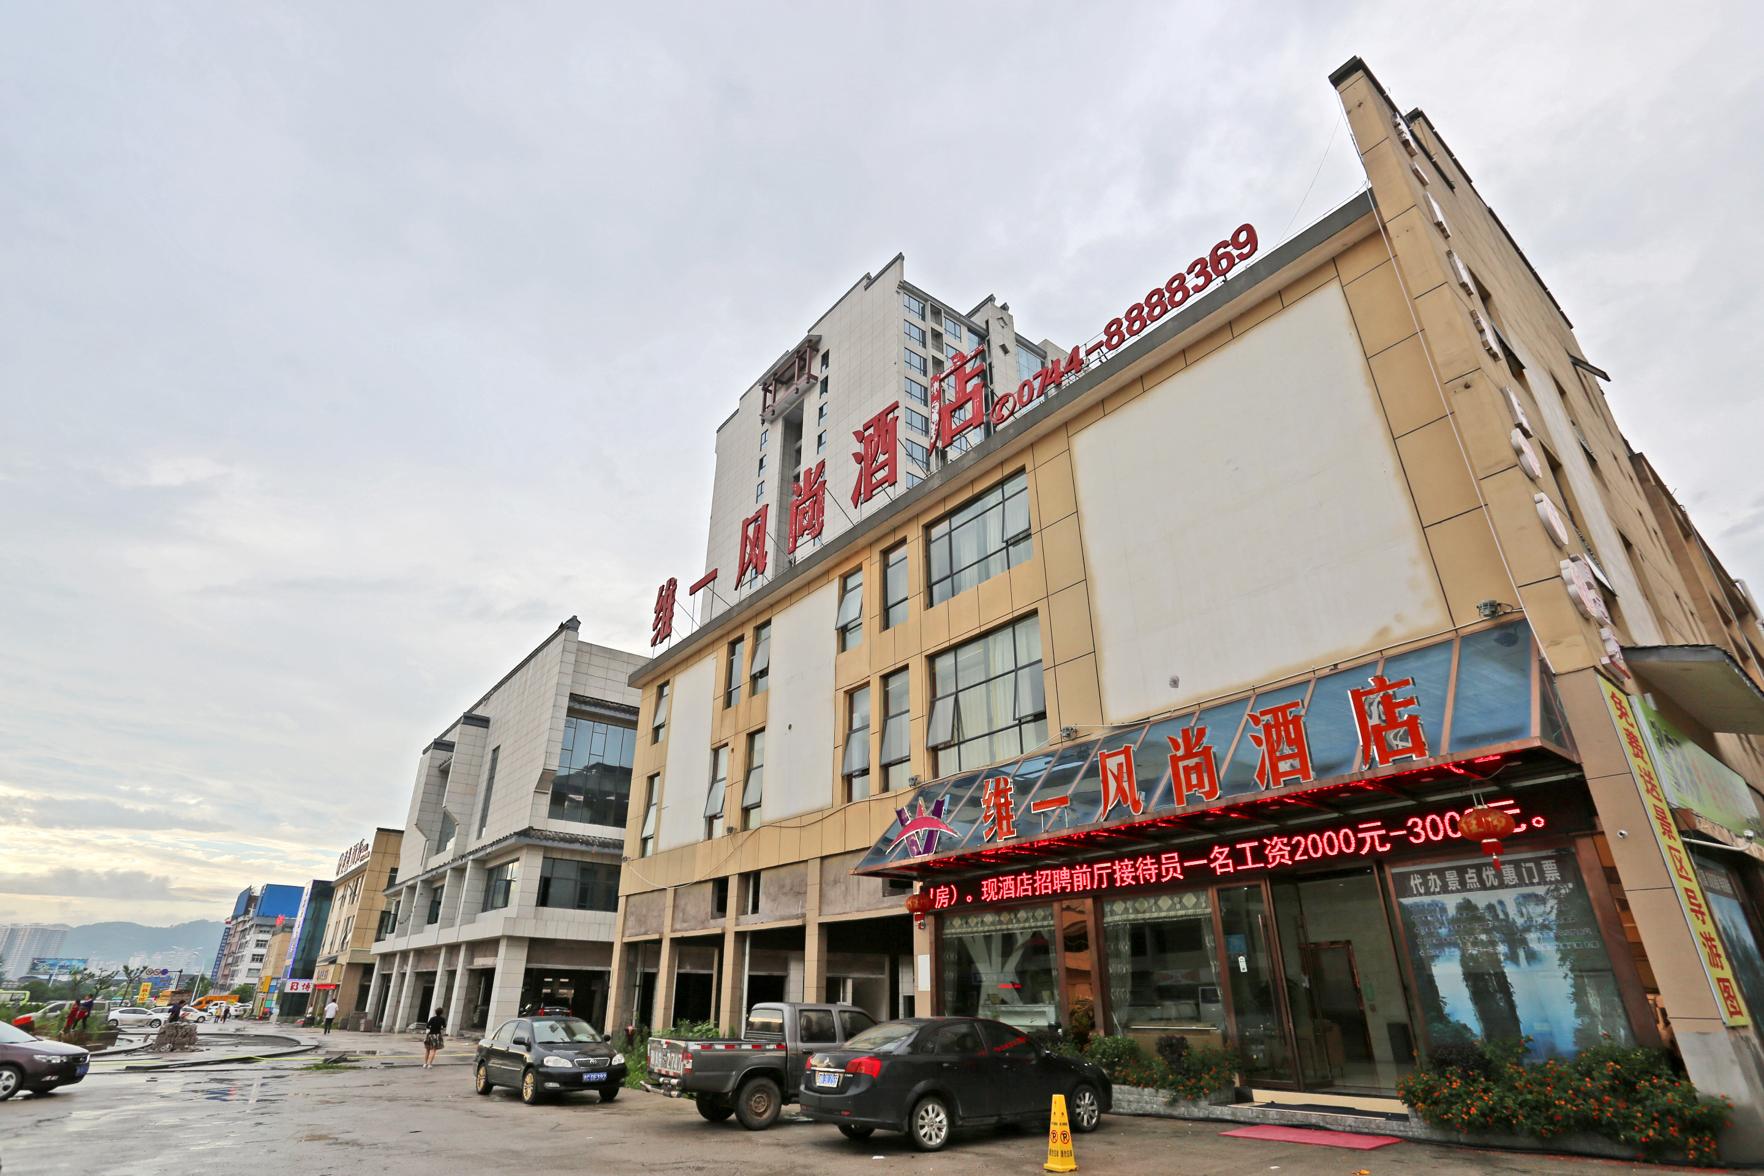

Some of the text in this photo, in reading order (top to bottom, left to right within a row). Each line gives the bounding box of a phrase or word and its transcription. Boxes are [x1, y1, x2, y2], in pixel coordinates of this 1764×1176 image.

[651, 344, 986, 647] 维一风尚酒店
[1015, 223, 1258, 408] 0744-8888369
[981, 676, 1430, 842] 维一风尚酒店
[929, 799, 1546, 909] 房）。现酒店招聘前厅接待员一名工资2000元-300。
[1409, 859, 1562, 894] 代办景点优惠门票
[1610, 691, 1745, 1019] 免费送景区导游图
